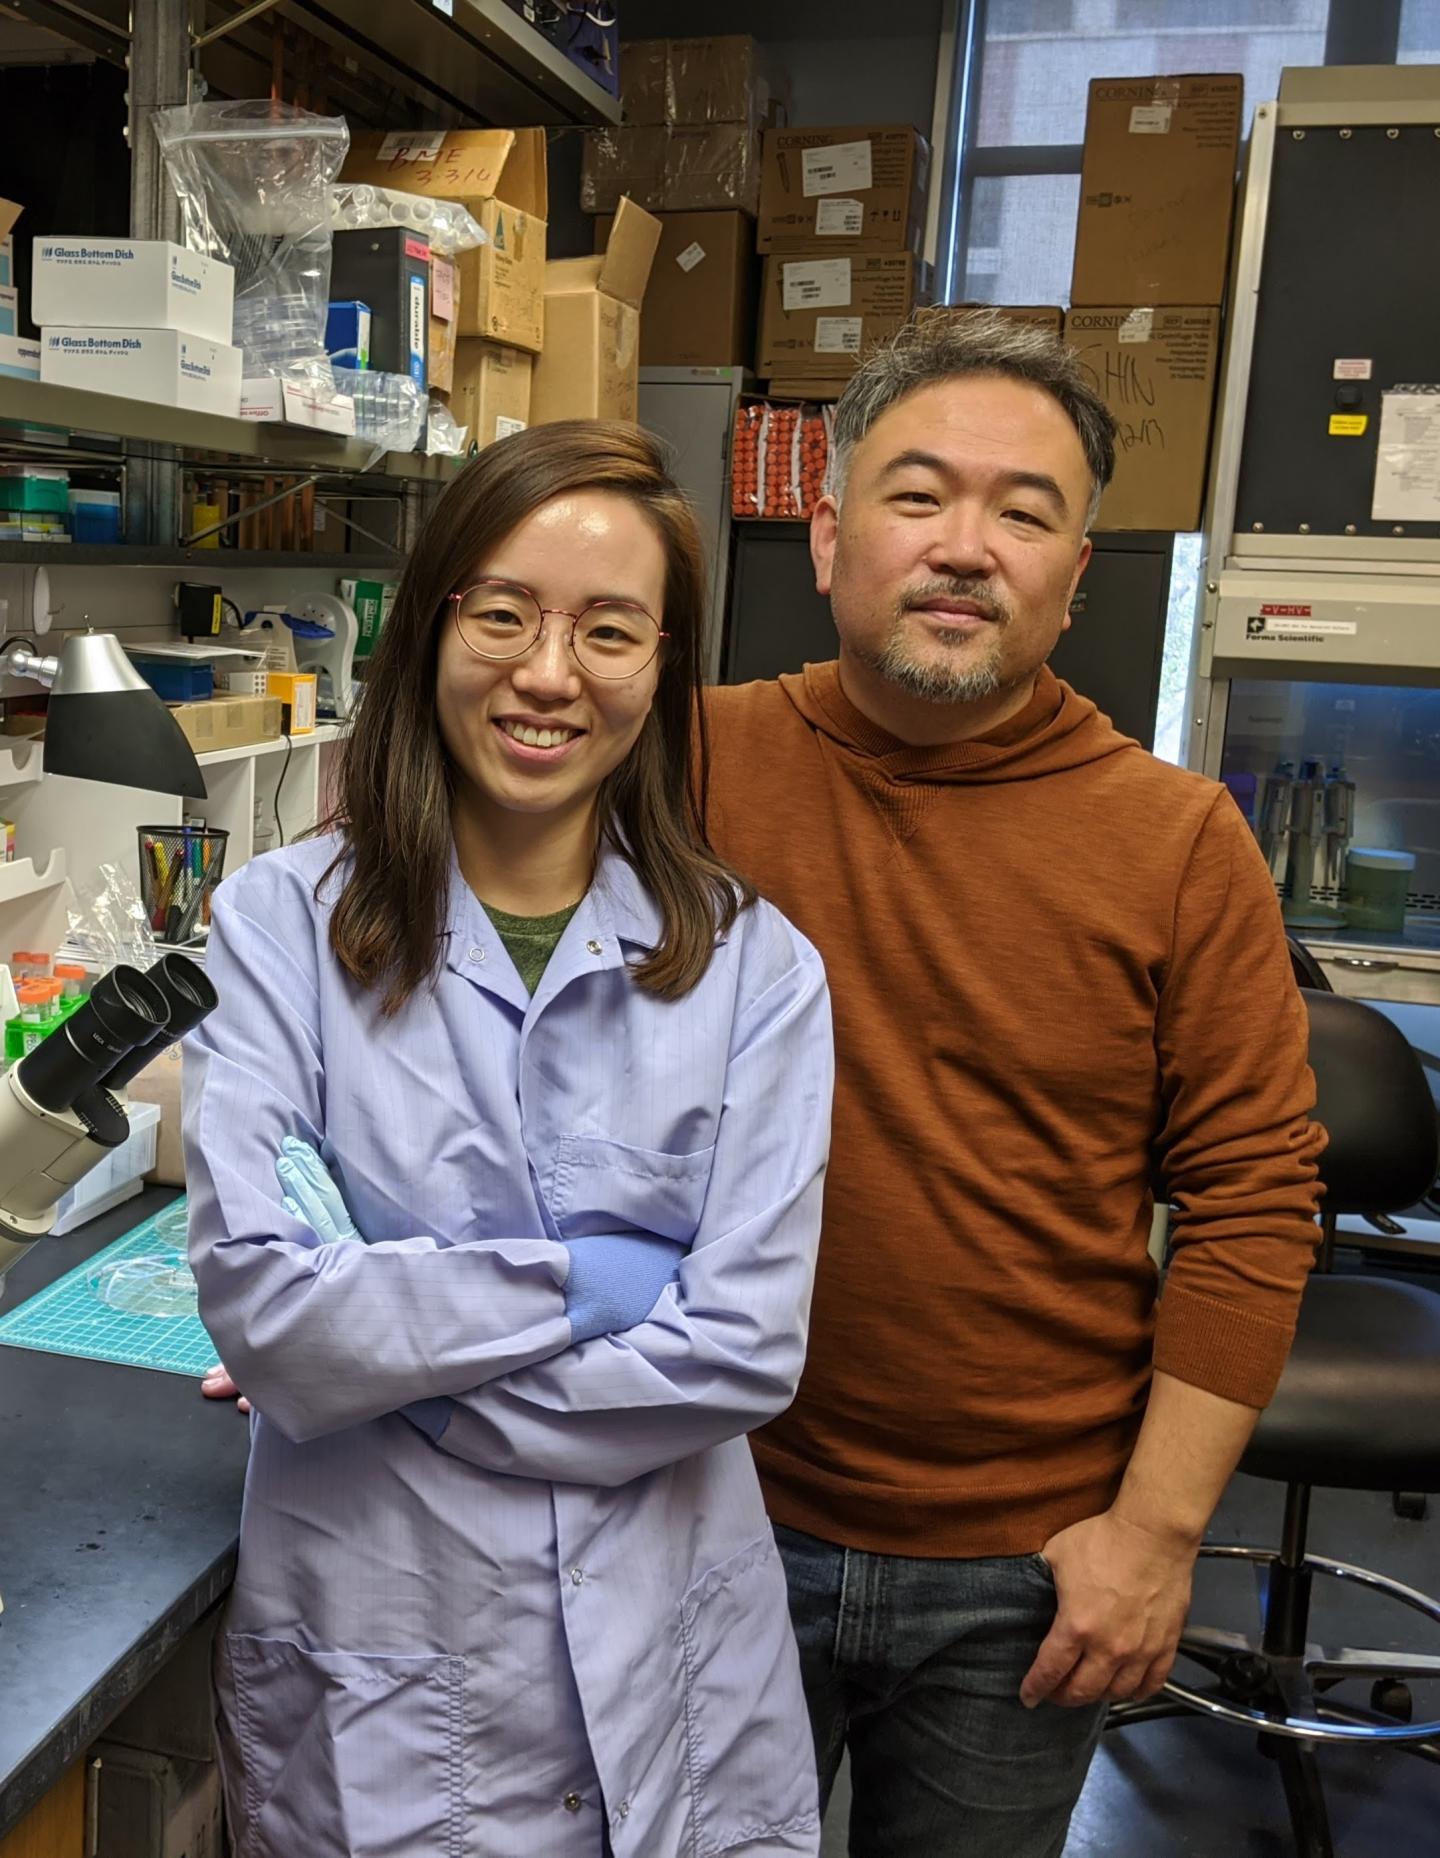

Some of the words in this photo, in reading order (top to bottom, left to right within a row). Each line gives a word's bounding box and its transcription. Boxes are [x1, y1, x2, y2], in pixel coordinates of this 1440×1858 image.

[387, 146, 466, 172] BME
[54, 248, 80, 258] Glass
[80, 248, 114, 259] Bottom
[114, 249, 134, 259] Dish
[61, 337, 87, 348] Glass
[87, 337, 121, 349] Bottom
[121, 338, 142, 349] Dish
[1246, 633, 1276, 641] Forma
[1278, 633, 1325, 643] Scientific
